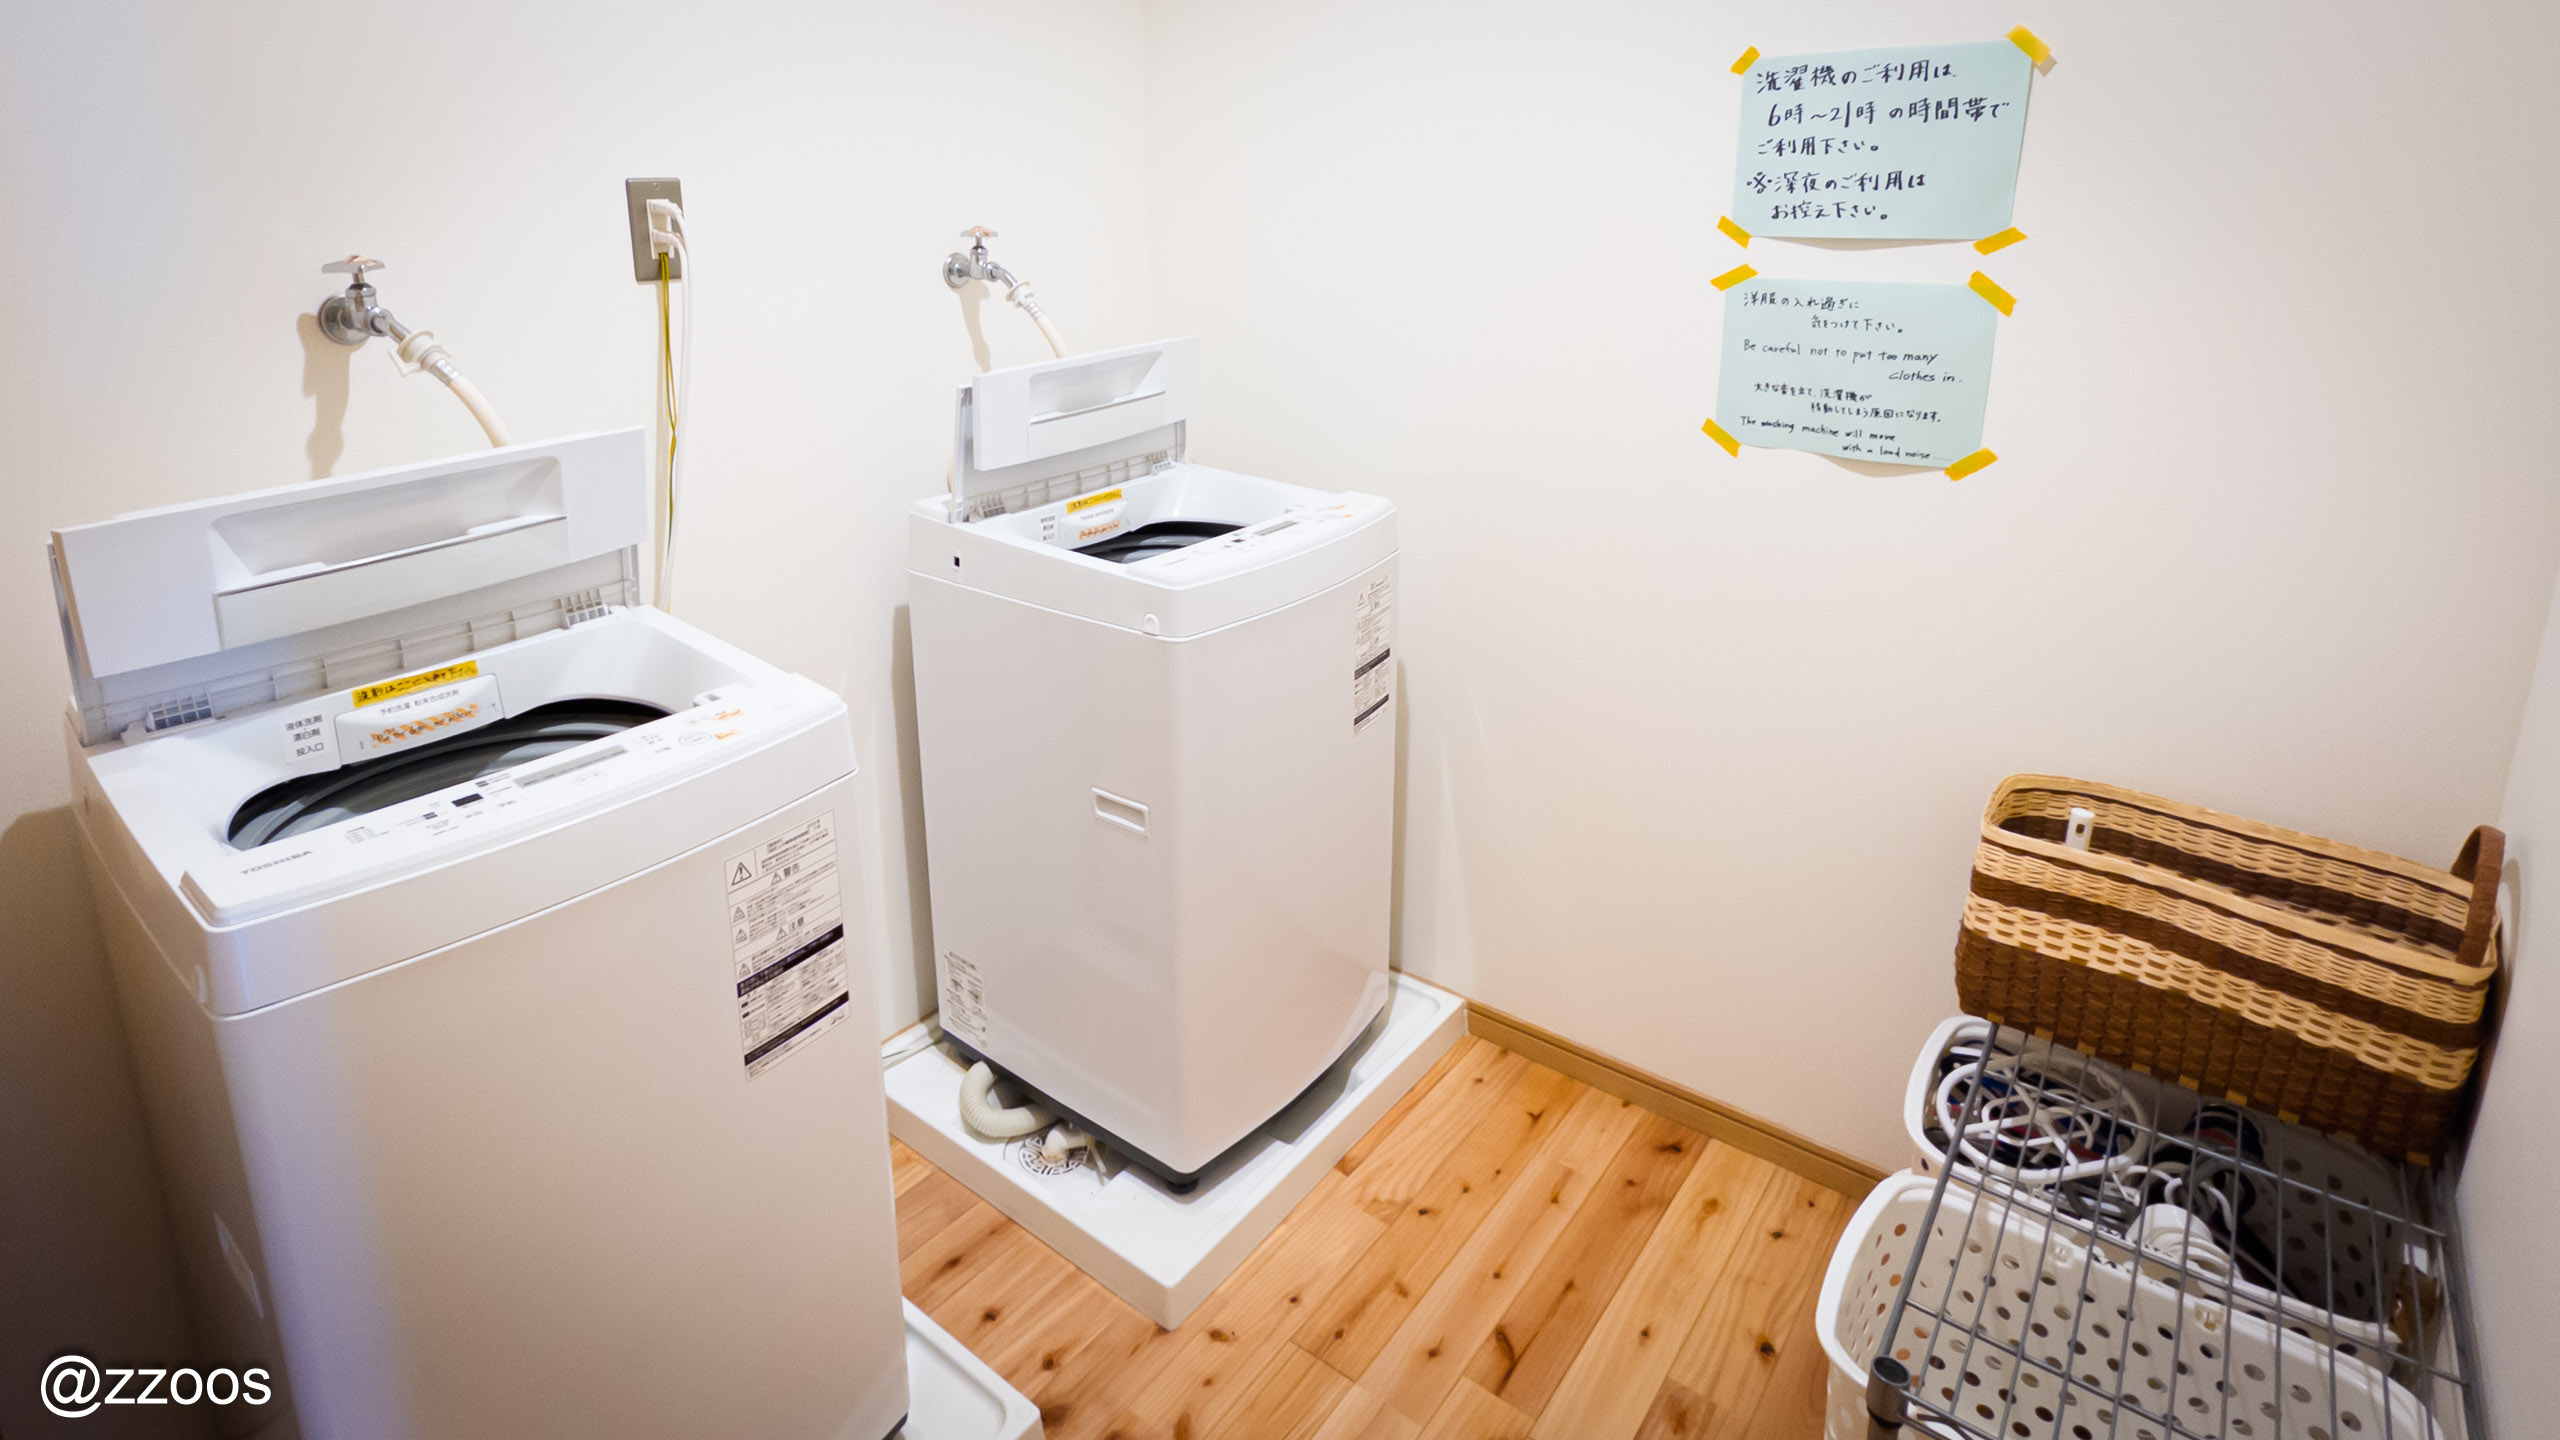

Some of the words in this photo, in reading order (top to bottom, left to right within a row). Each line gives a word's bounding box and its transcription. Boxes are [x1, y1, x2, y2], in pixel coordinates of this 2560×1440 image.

[1756, 59, 1954, 94] 洗濯機のご利用は
[1744, 339, 1757, 352] Be
[1762, 342, 1801, 355] careful
[1810, 347, 1828, 356] not
[1835, 348, 1847, 358] to
[1852, 350, 1873, 364] put
[1877, 351, 1898, 361] too
[1902, 352, 1939, 365] many
[1740, 416, 1757, 426] The
[1761, 419, 1795, 433] washing
[1802, 423, 1840, 438] machine
[1845, 429, 1863, 438] will
[1869, 433, 1896, 441] move
[1842, 443, 1862, 453] with
